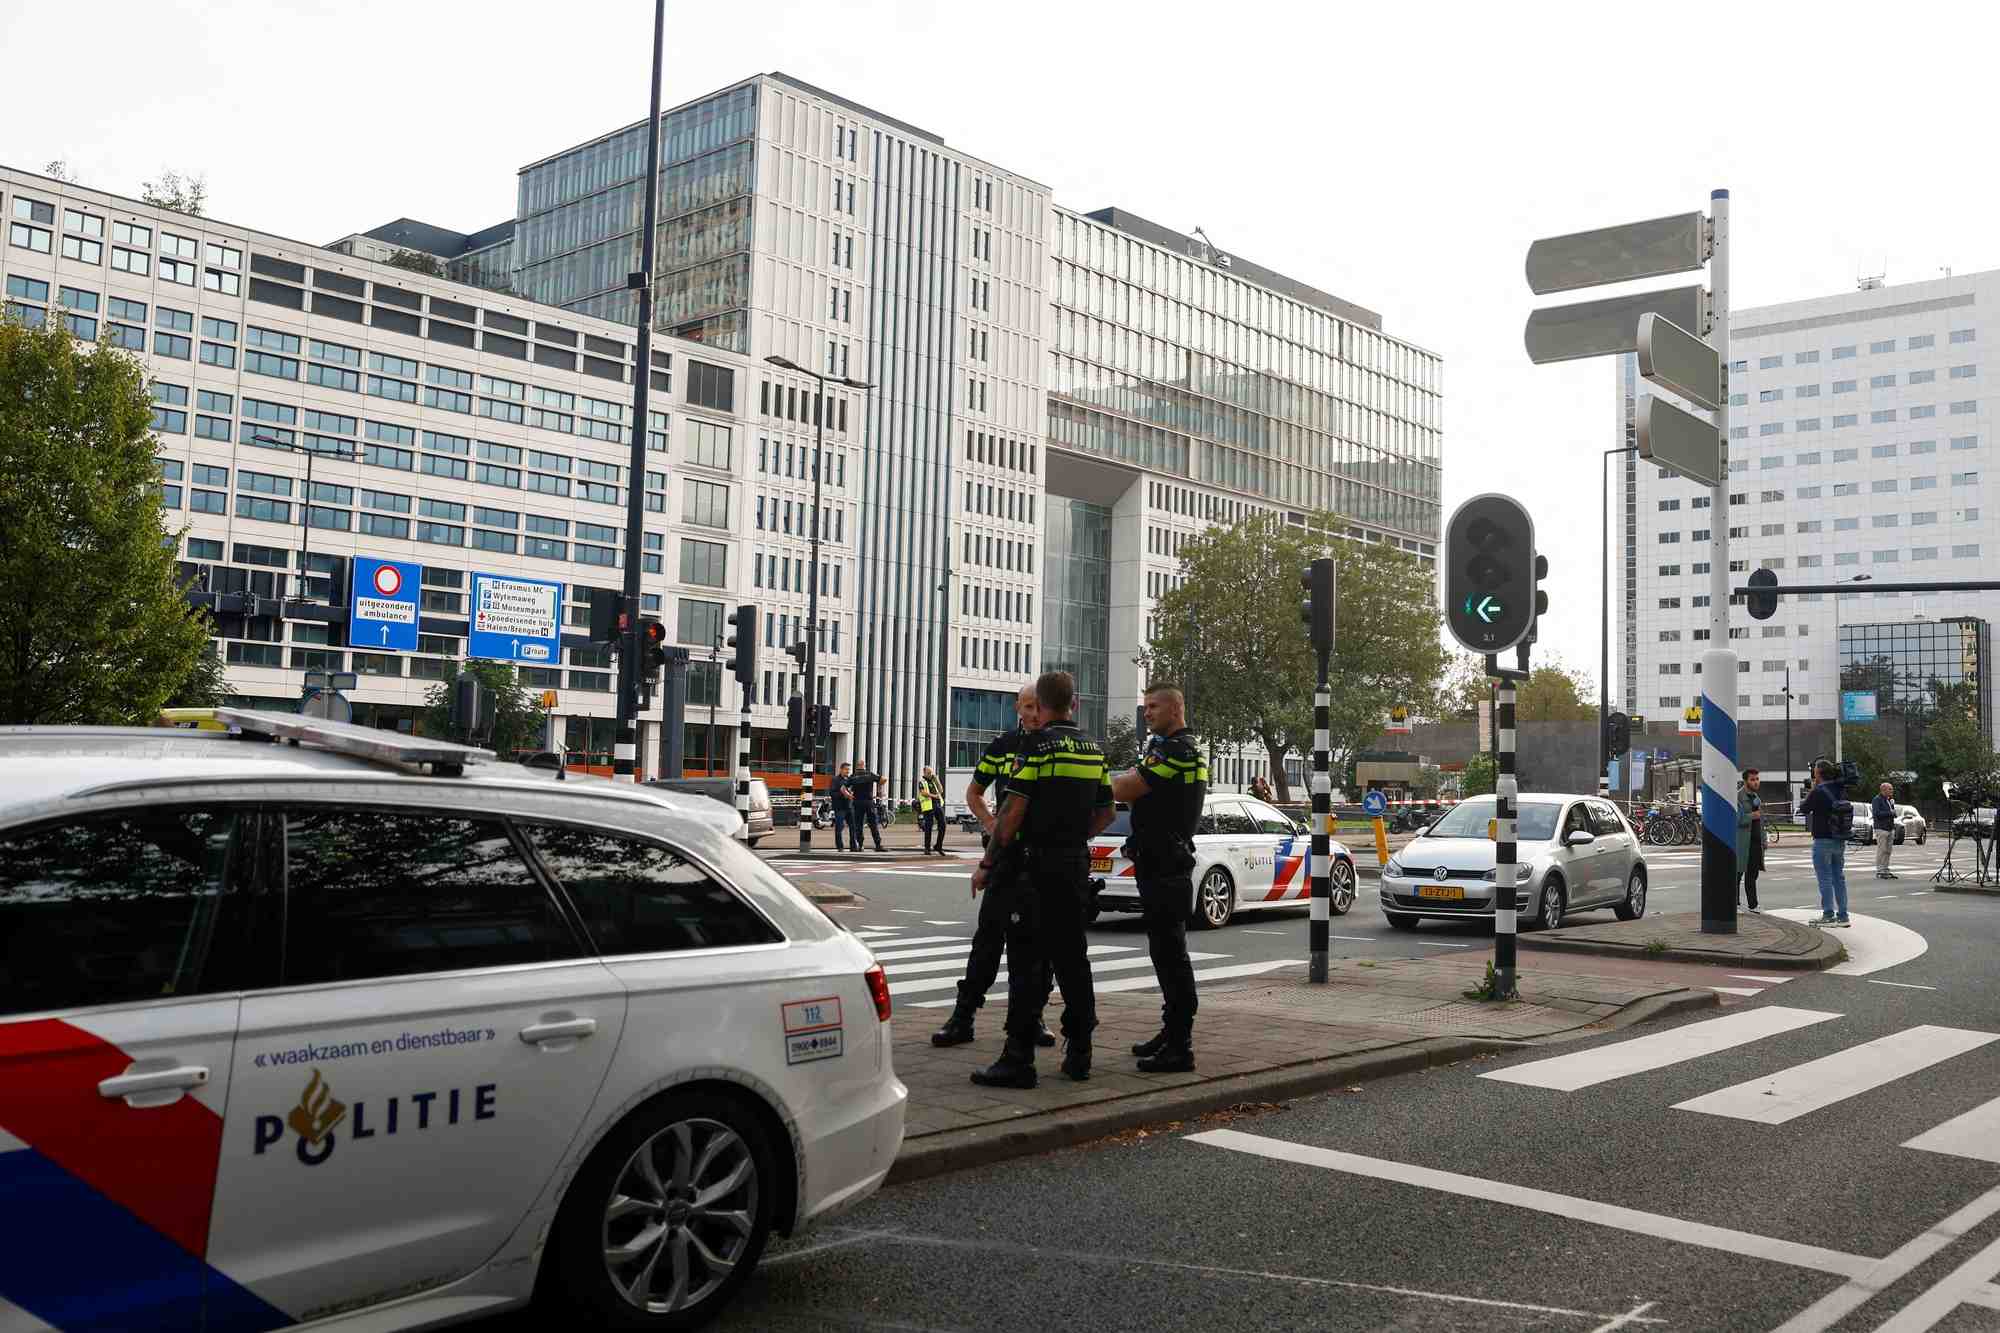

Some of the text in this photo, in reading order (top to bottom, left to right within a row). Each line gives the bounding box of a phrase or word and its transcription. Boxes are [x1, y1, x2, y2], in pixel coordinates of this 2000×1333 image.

[502, 581, 531, 592] Erasmus
[493, 592, 536, 605] Wytemaweg
[359, 600, 412, 611] uitgezonderd
[501, 603, 546, 615] Museumpark
[364, 610, 408, 620] ambulance
[1244, 855, 1273, 869] POLITIE
[804, 1004, 824, 1025] 112
[269, 1042, 368, 1065] waakzaam
[371, 1039, 392, 1054] en
[396, 1028, 481, 1051] dienstbaar
[253, 1083, 496, 1166] POLITIE
